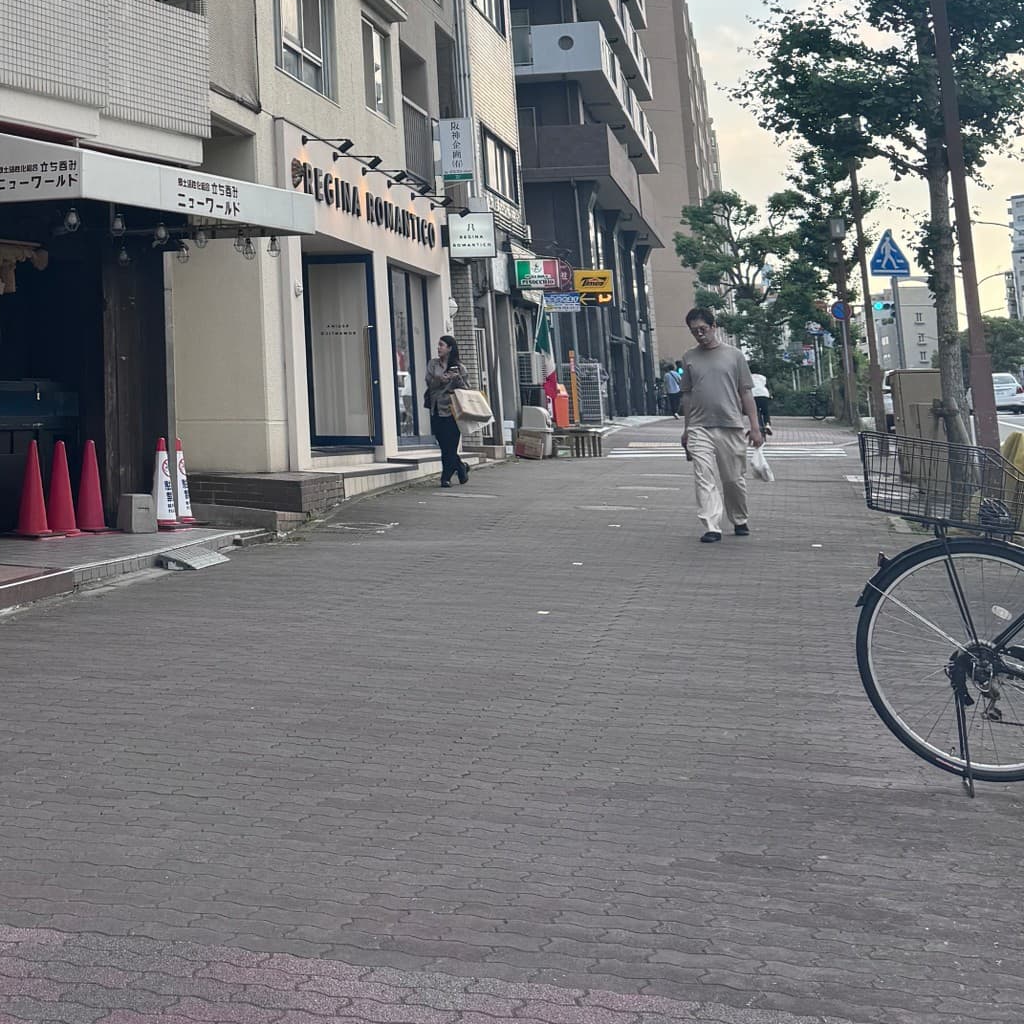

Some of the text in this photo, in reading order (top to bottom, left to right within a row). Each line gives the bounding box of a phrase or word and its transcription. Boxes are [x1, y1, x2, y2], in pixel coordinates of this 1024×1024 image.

[177, 193, 240, 216] ニューワールド
[302, 161, 436, 249] REGINA ROMANTICO
